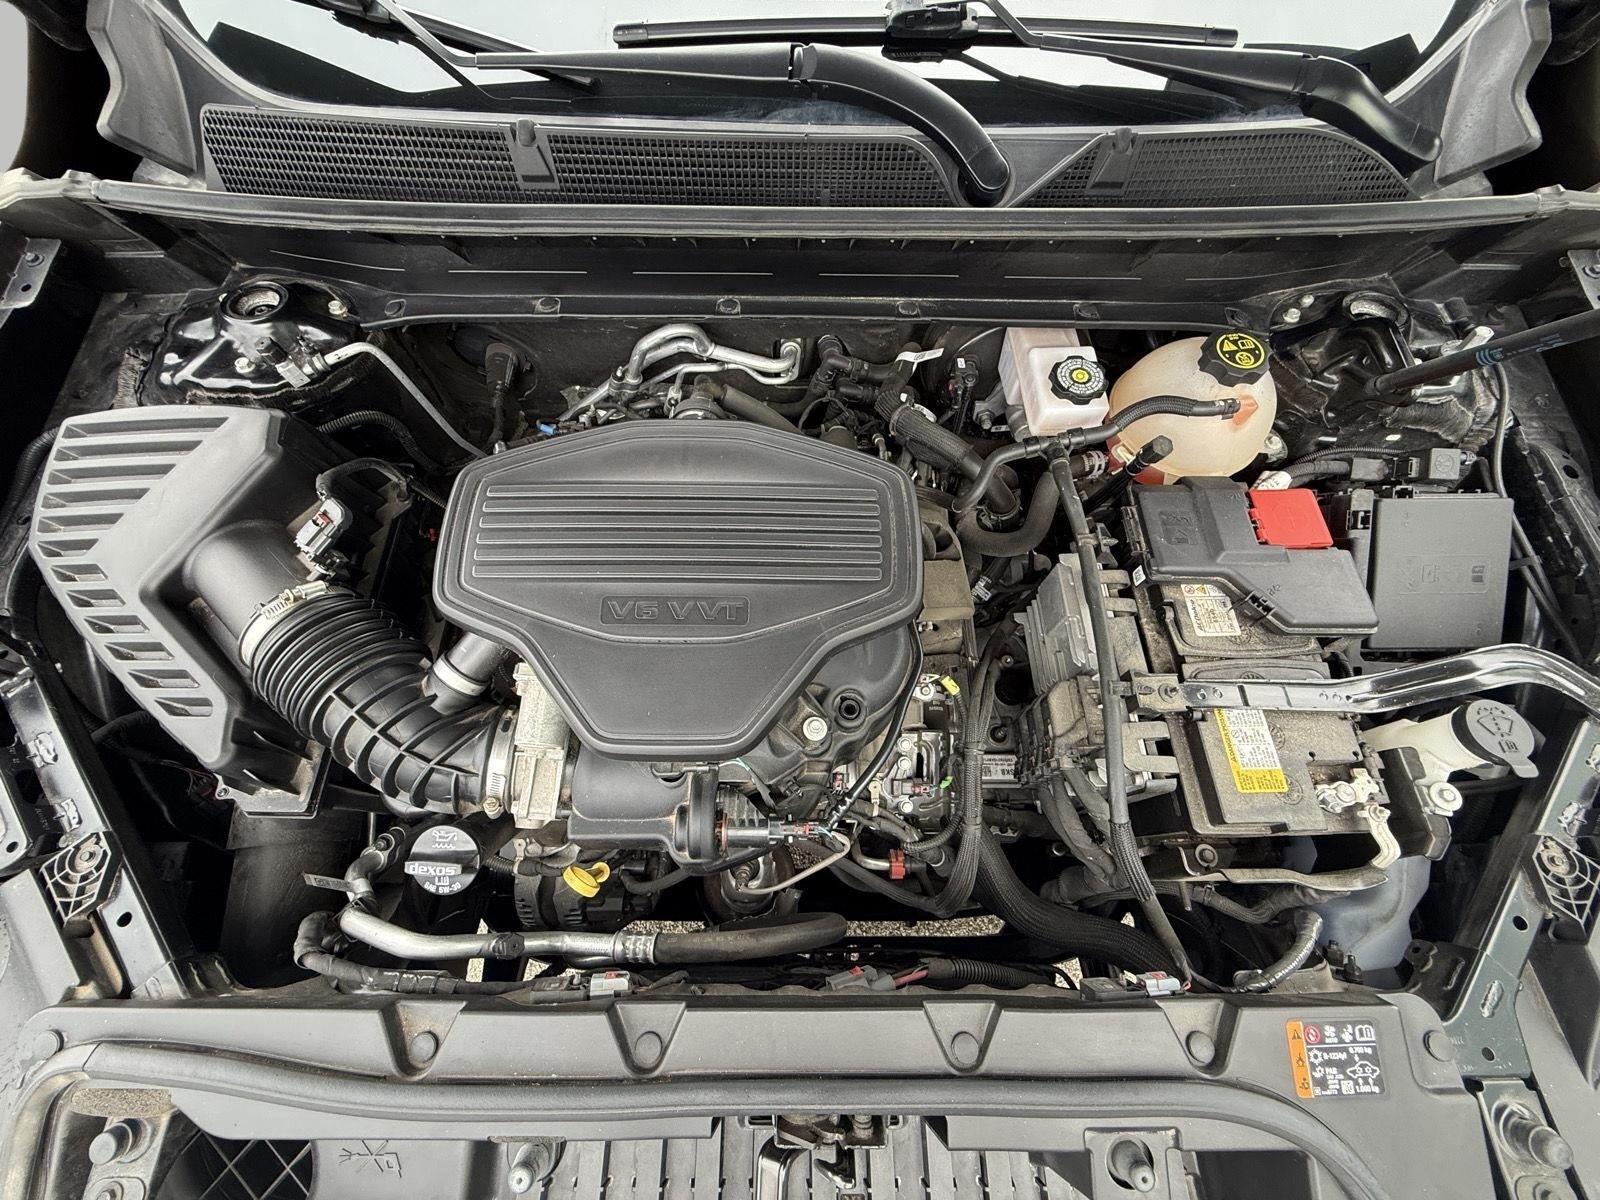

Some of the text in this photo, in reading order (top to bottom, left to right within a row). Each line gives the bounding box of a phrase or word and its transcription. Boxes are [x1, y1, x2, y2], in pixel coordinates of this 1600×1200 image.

[607, 601, 744, 620] V6 VVT
[409, 862, 457, 876] dexos
[438, 882, 462, 894] 5W-30
